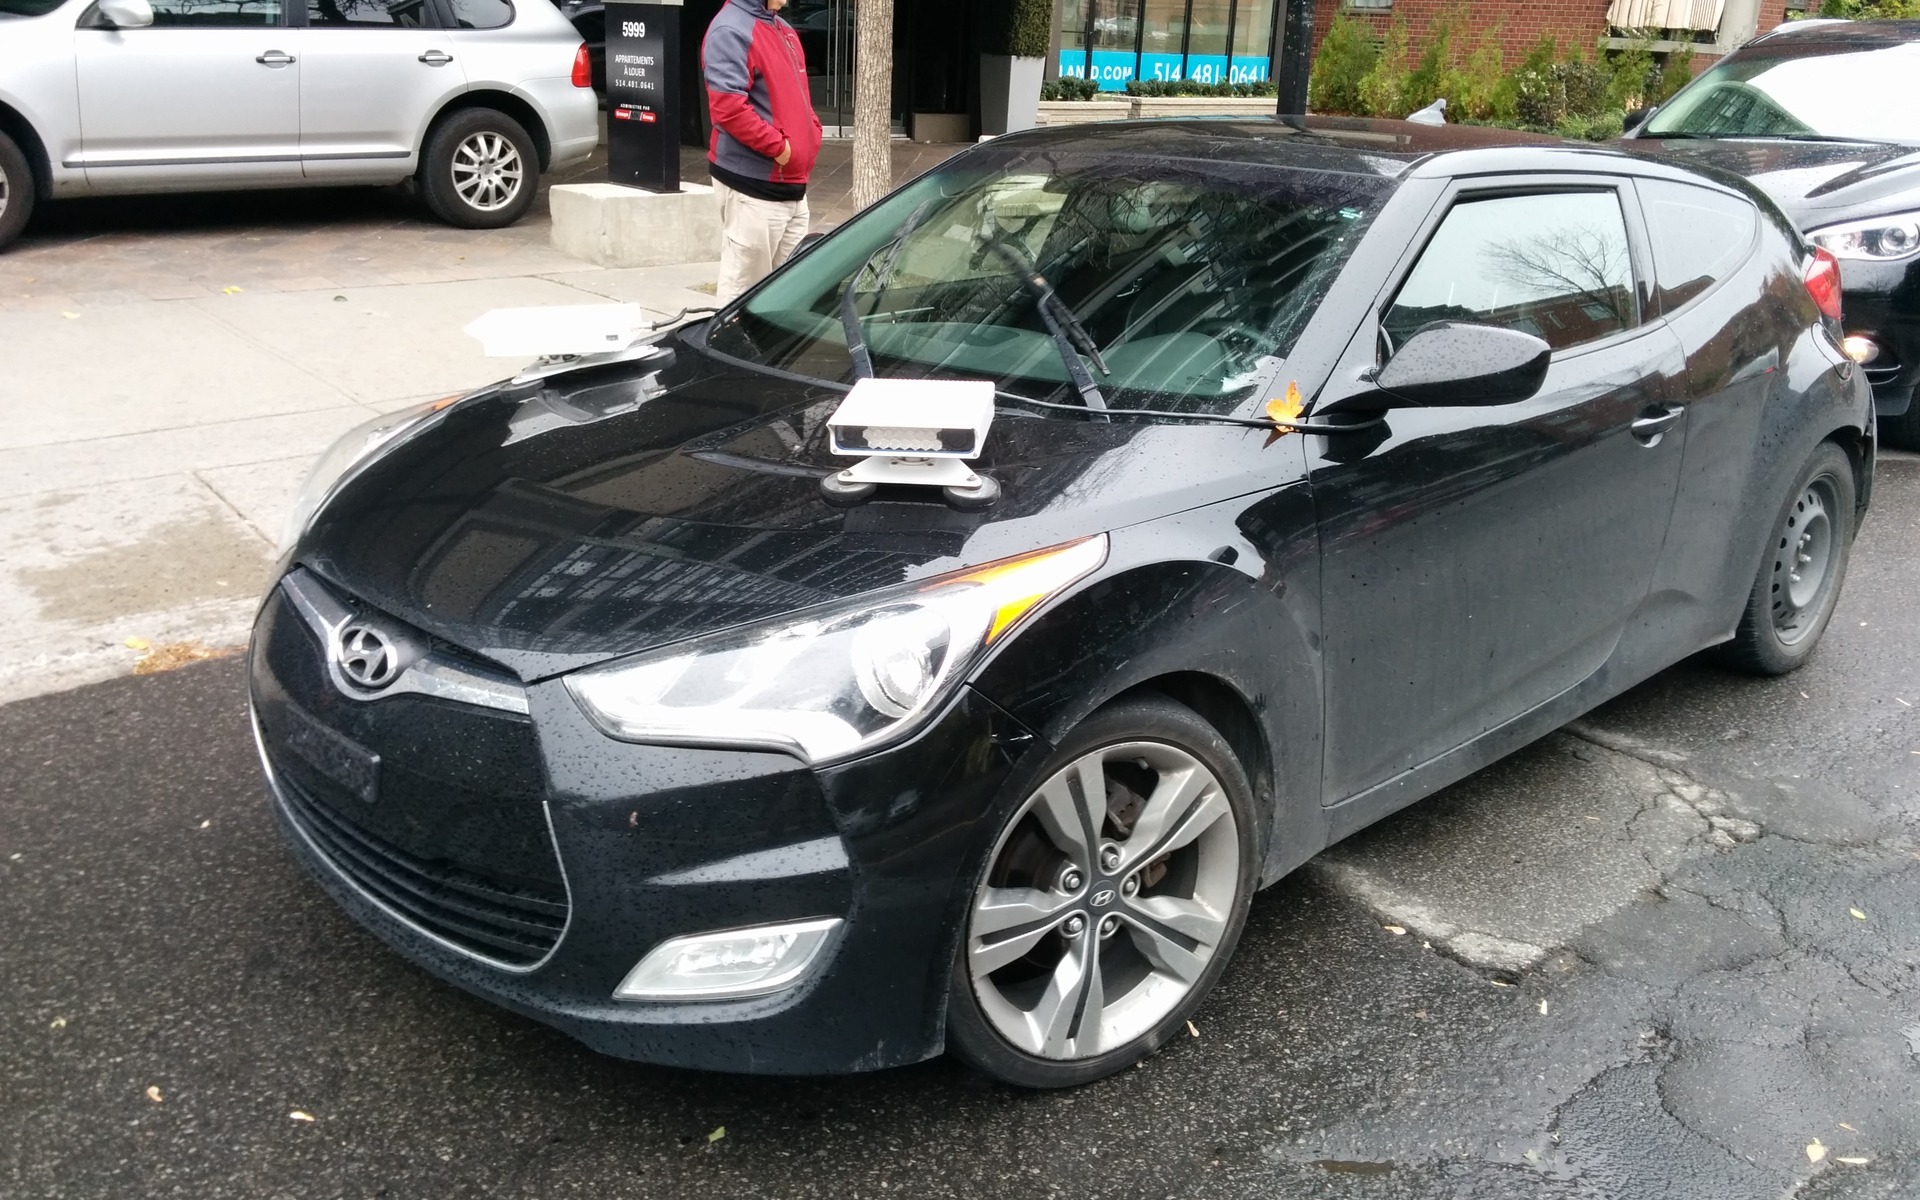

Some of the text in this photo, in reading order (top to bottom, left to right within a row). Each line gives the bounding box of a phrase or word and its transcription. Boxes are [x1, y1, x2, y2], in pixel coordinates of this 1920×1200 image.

[622, 22, 645, 38] 5999
[615, 55, 654, 66] APPARTEMENTS
[624, 65, 645, 76] À LOUER
[1155, 63, 1180, 82] 514
[1192, 64, 1220, 85] 481
[1229, 64, 1265, 85] 0641
[615, 79, 654, 90] 514.481.0641
